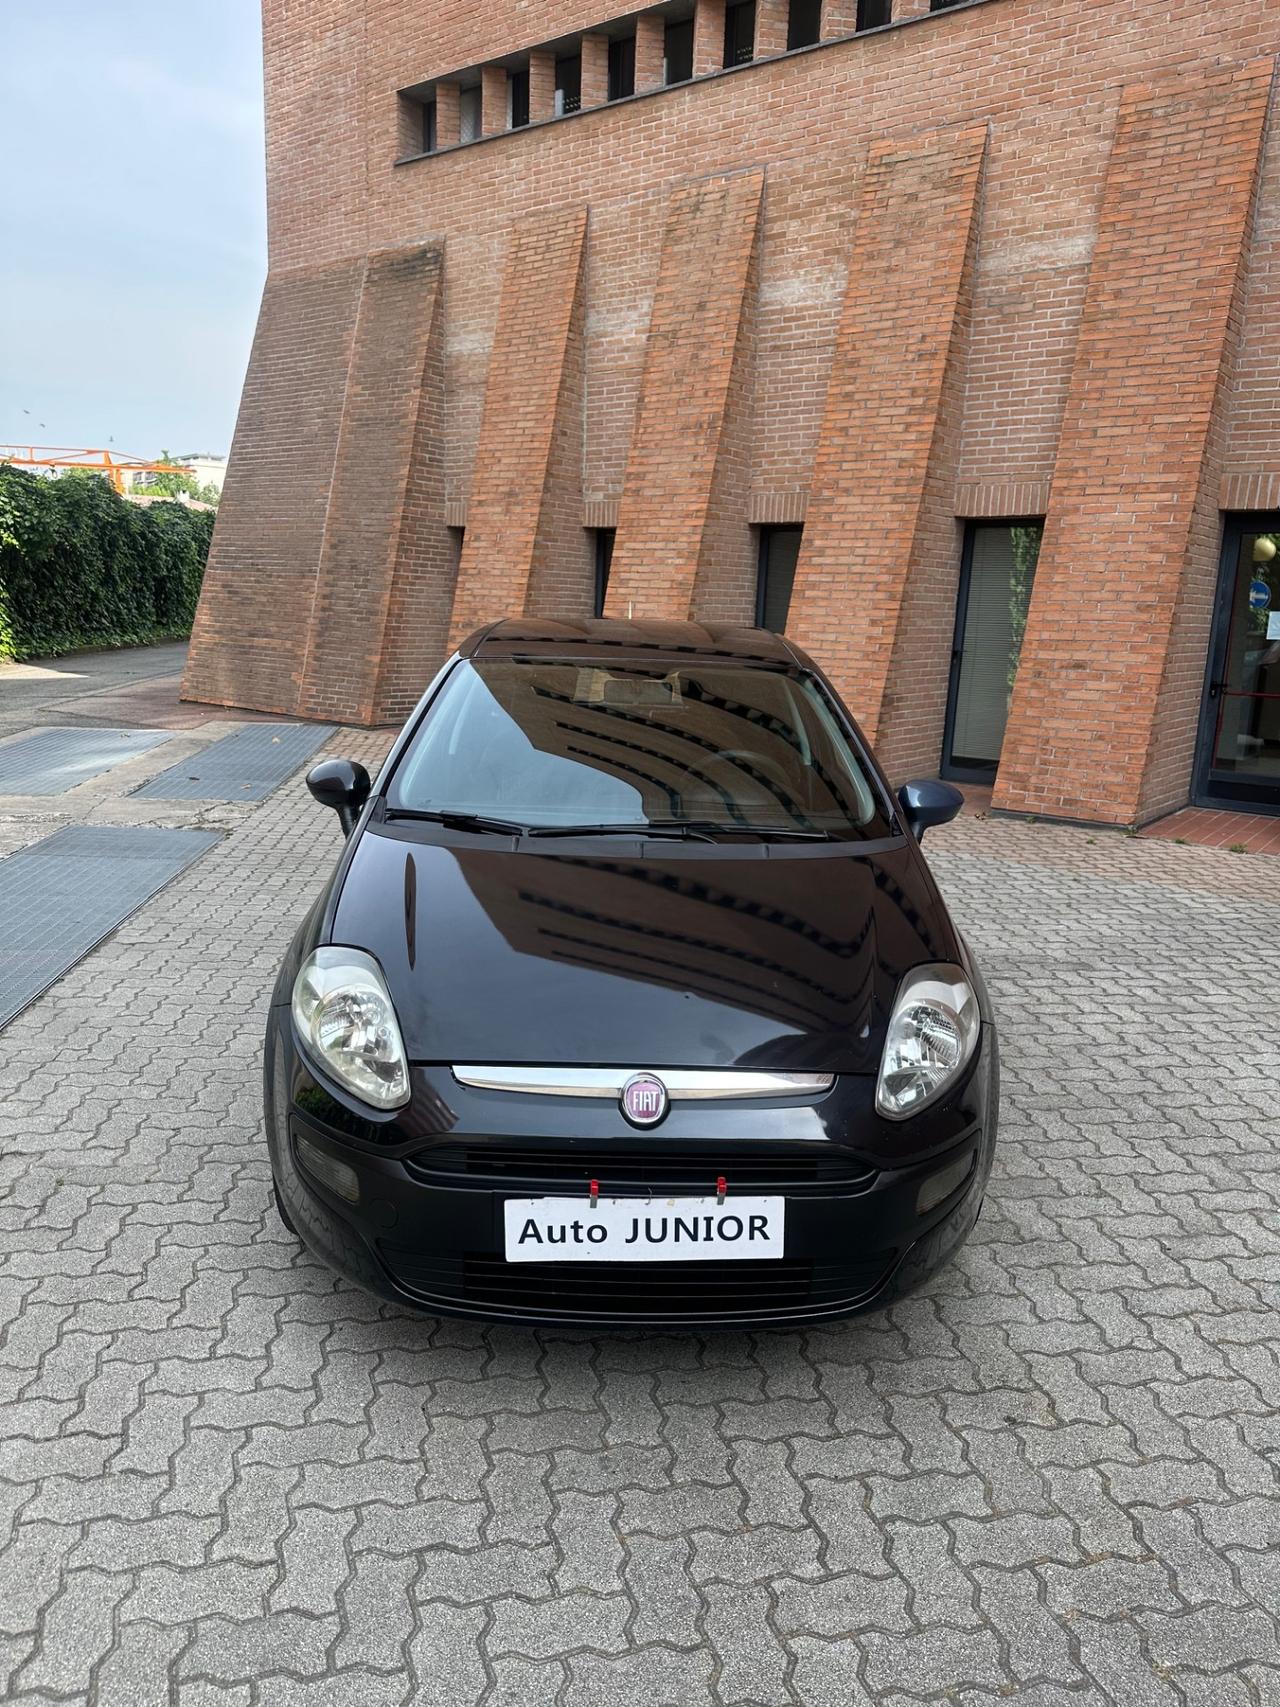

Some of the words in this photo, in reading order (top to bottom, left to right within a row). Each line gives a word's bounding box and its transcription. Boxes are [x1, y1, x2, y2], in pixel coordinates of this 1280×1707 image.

[633, 1091, 658, 1111] FIAT
[518, 1218, 608, 1244] Auto
[625, 1215, 771, 1243] JUNIOR
